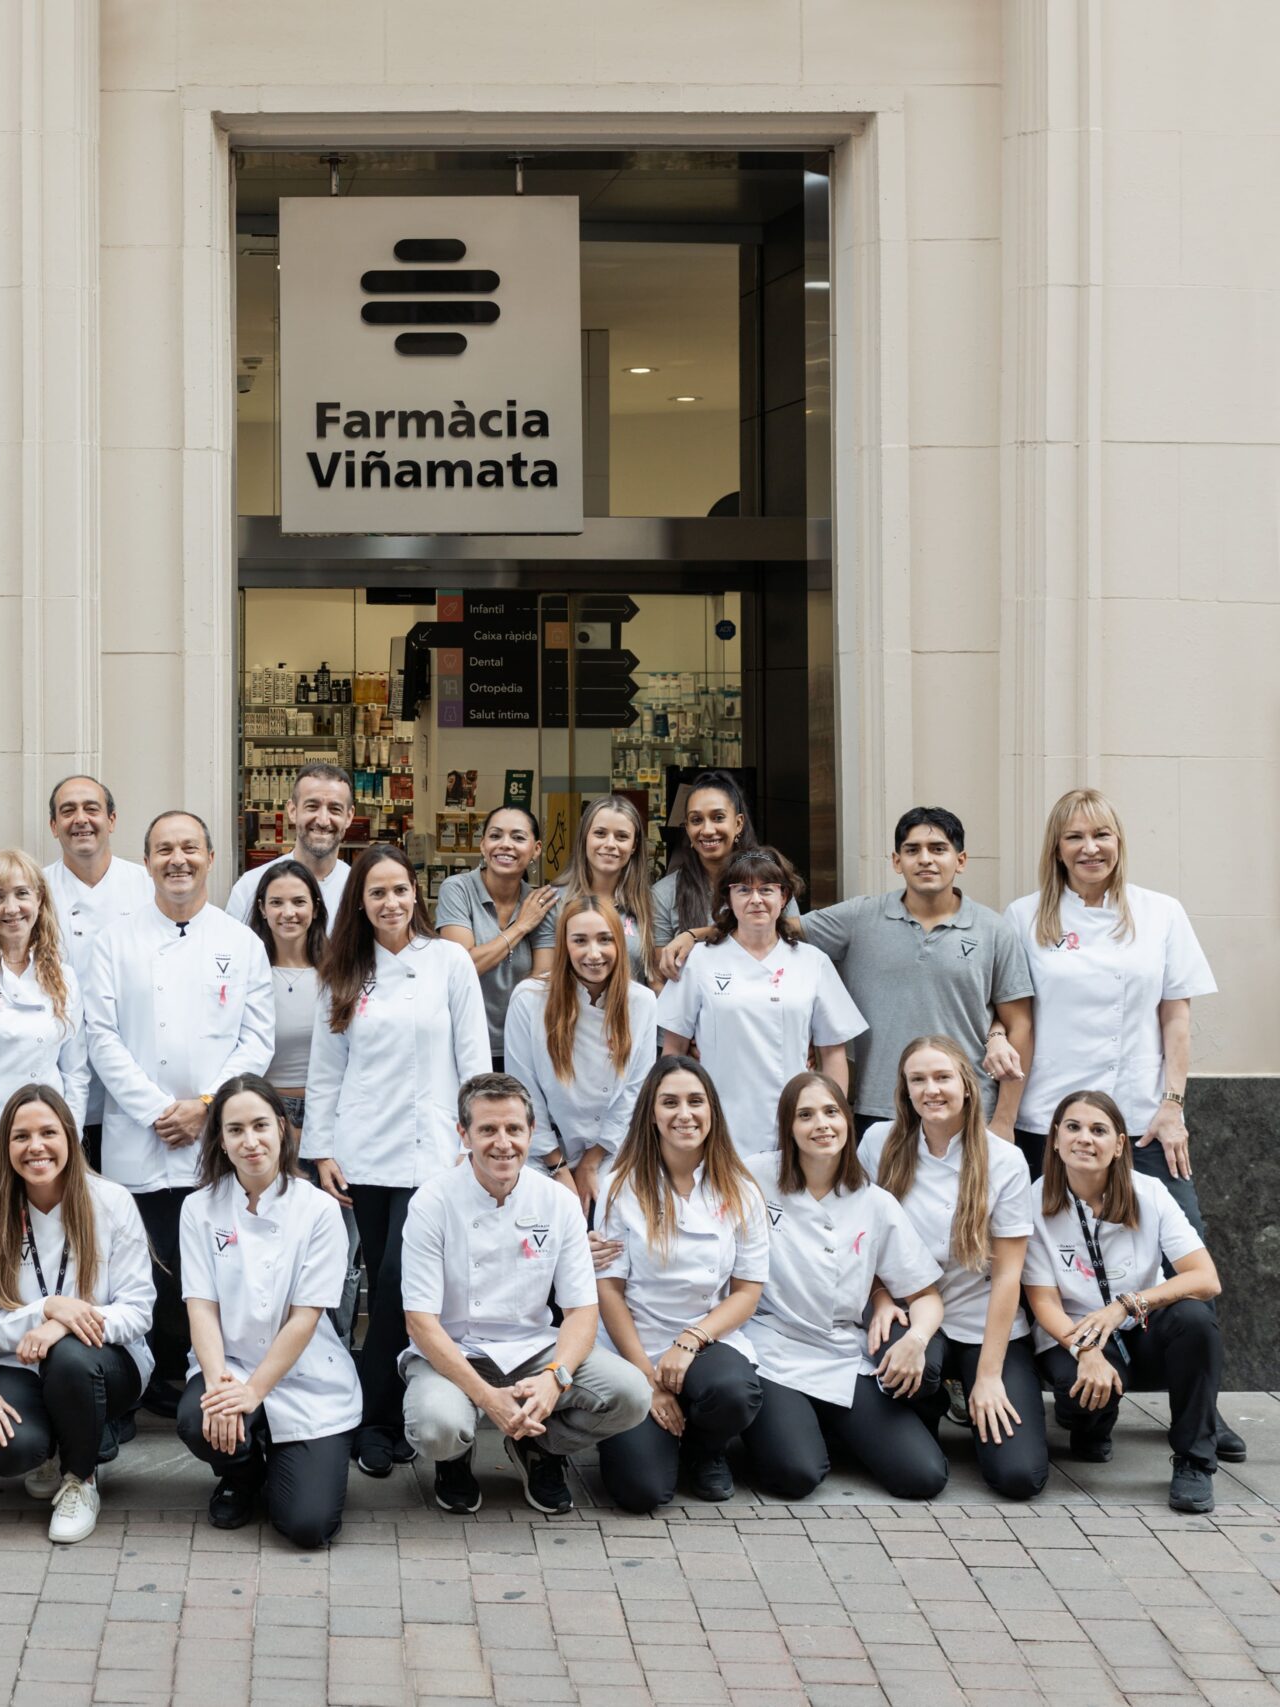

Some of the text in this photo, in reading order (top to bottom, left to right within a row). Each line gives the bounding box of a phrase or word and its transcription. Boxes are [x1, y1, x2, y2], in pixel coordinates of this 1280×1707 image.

[315, 399, 551, 439] Farmàcia
[306, 450, 559, 489] Viñamata
[469, 603, 505, 614] Infantil
[473, 630, 538, 644] Caixa ràpida
[469, 656, 504, 667] Dental
[469, 682, 523, 695] Ortopèdia
[469, 709, 496, 720] Salut
